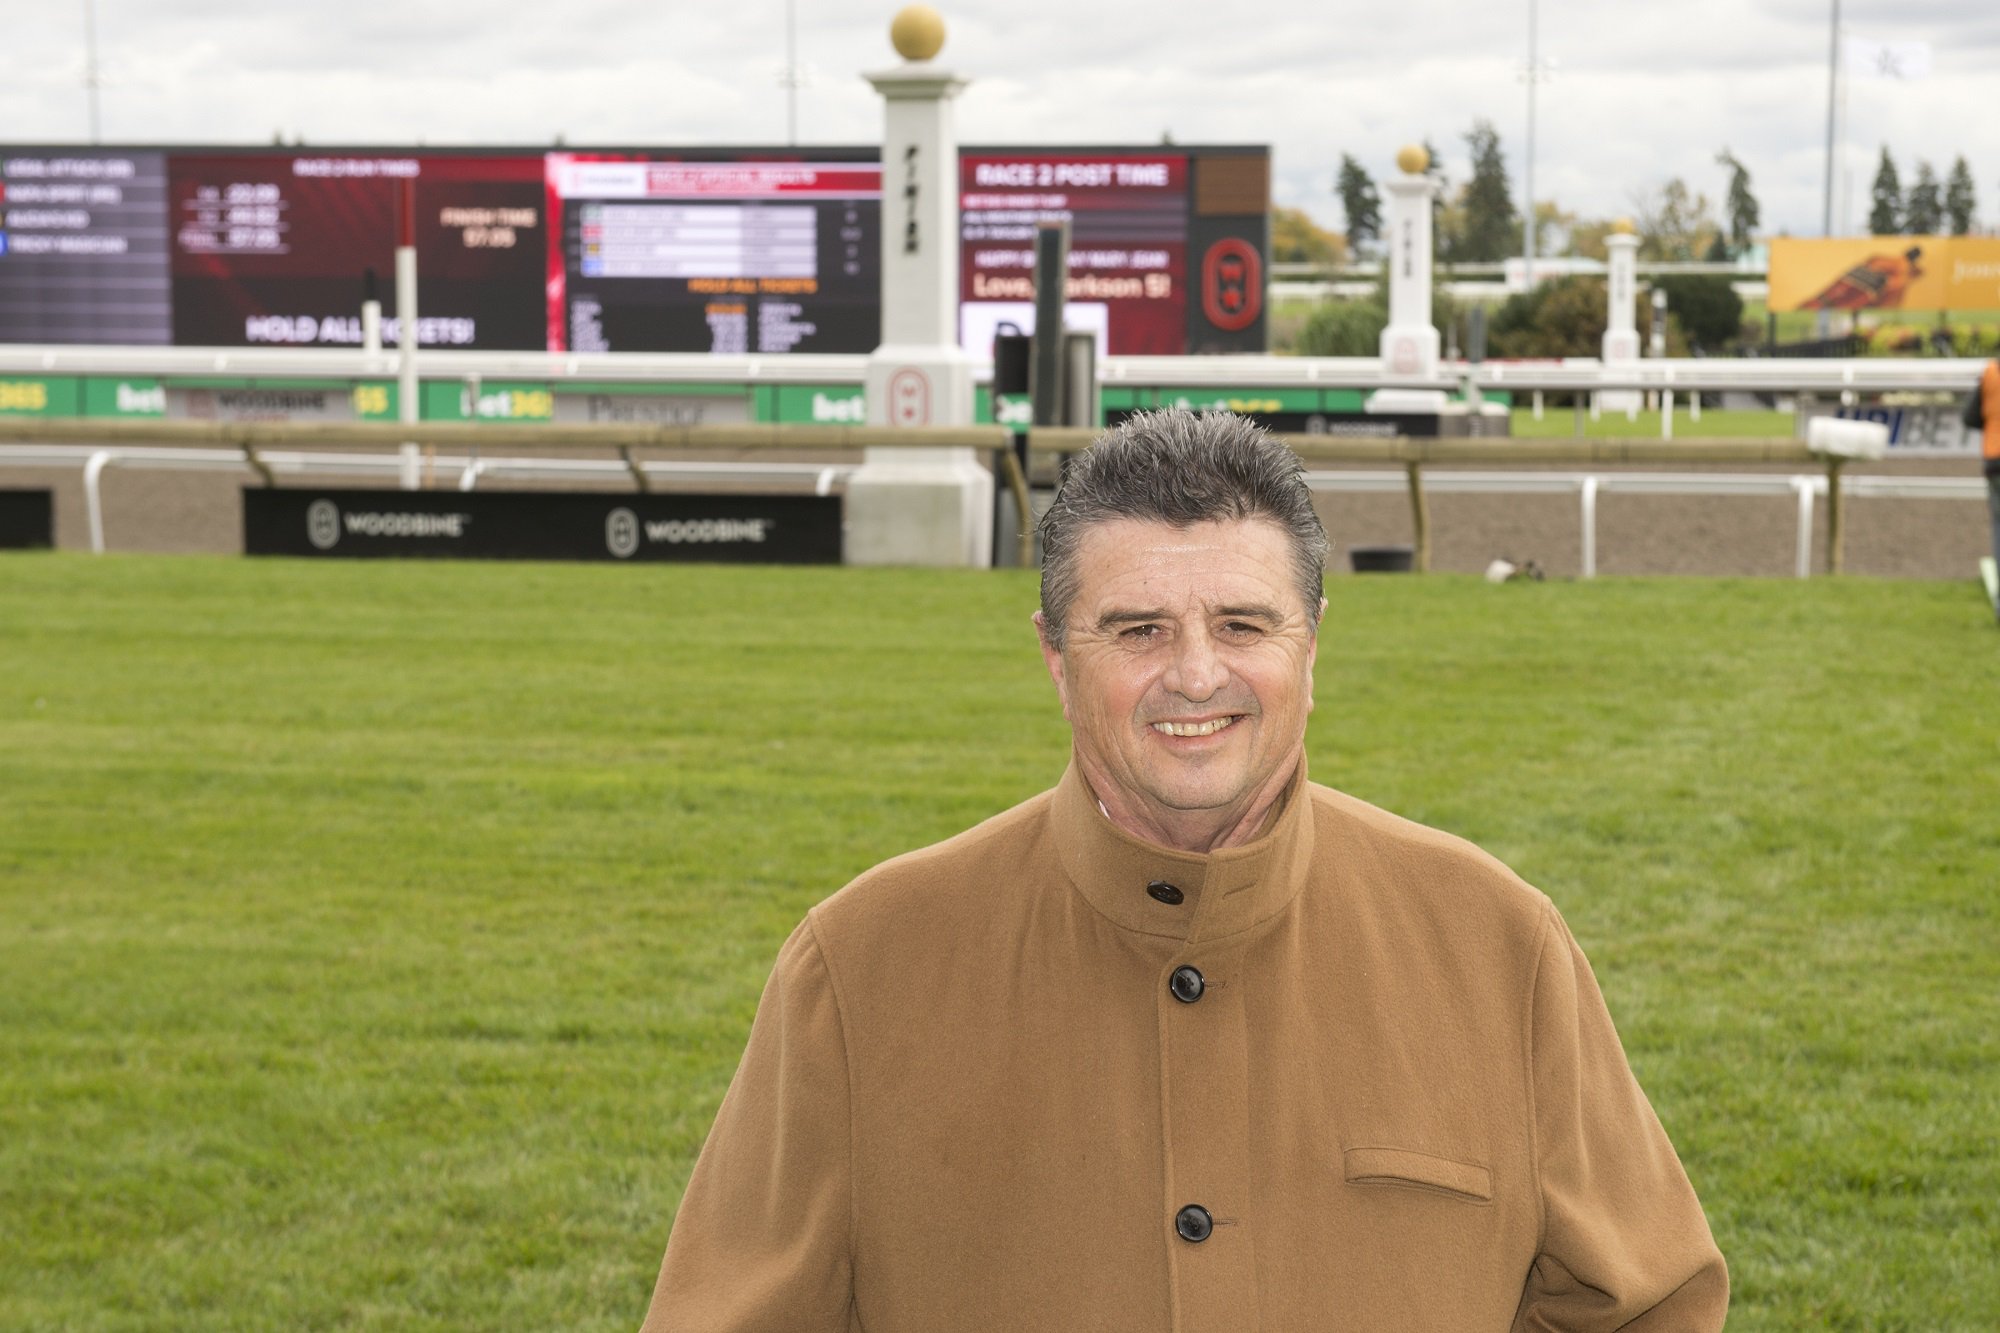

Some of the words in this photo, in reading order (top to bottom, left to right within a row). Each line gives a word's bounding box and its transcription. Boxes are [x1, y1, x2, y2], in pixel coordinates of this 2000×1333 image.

[976, 163, 1035, 187] RACE
[1036, 163, 1053, 187] 2
[1054, 163, 1112, 187] POST
[1114, 163, 1169, 187] TIME
[497, 207, 538, 228] TIME
[973, 272, 1037, 299] Love,
[1062, 272, 1143, 299] arkson
[246, 315, 318, 342] HOLD
[319, 315, 365, 342] ALL
[0, 382, 47, 410] 365
[116, 384, 166, 412] bet
[812, 393, 864, 420] bet
[345, 512, 464, 537] WOODBINE
[645, 518, 766, 543] WOODBINE
